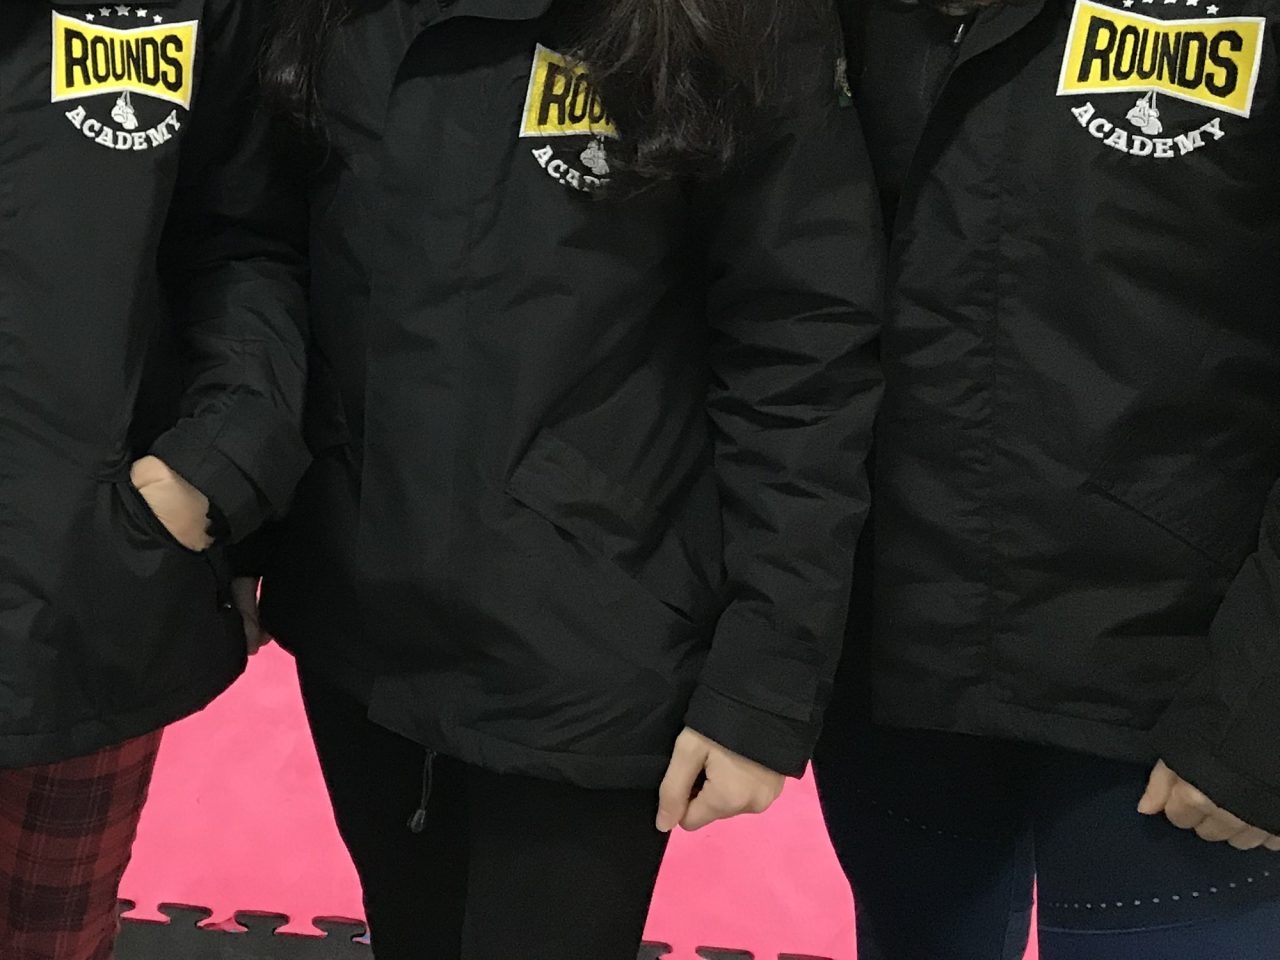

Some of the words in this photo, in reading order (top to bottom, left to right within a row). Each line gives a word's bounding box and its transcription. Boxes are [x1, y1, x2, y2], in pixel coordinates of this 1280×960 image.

[63, 26, 184, 93] ROUNDS
[1076, 14, 1243, 99] ROUNDS
[537, 61, 612, 126] ROU
[64, 105, 181, 151] ACADEMY
[1070, 101, 1226, 158] ACADEMY
